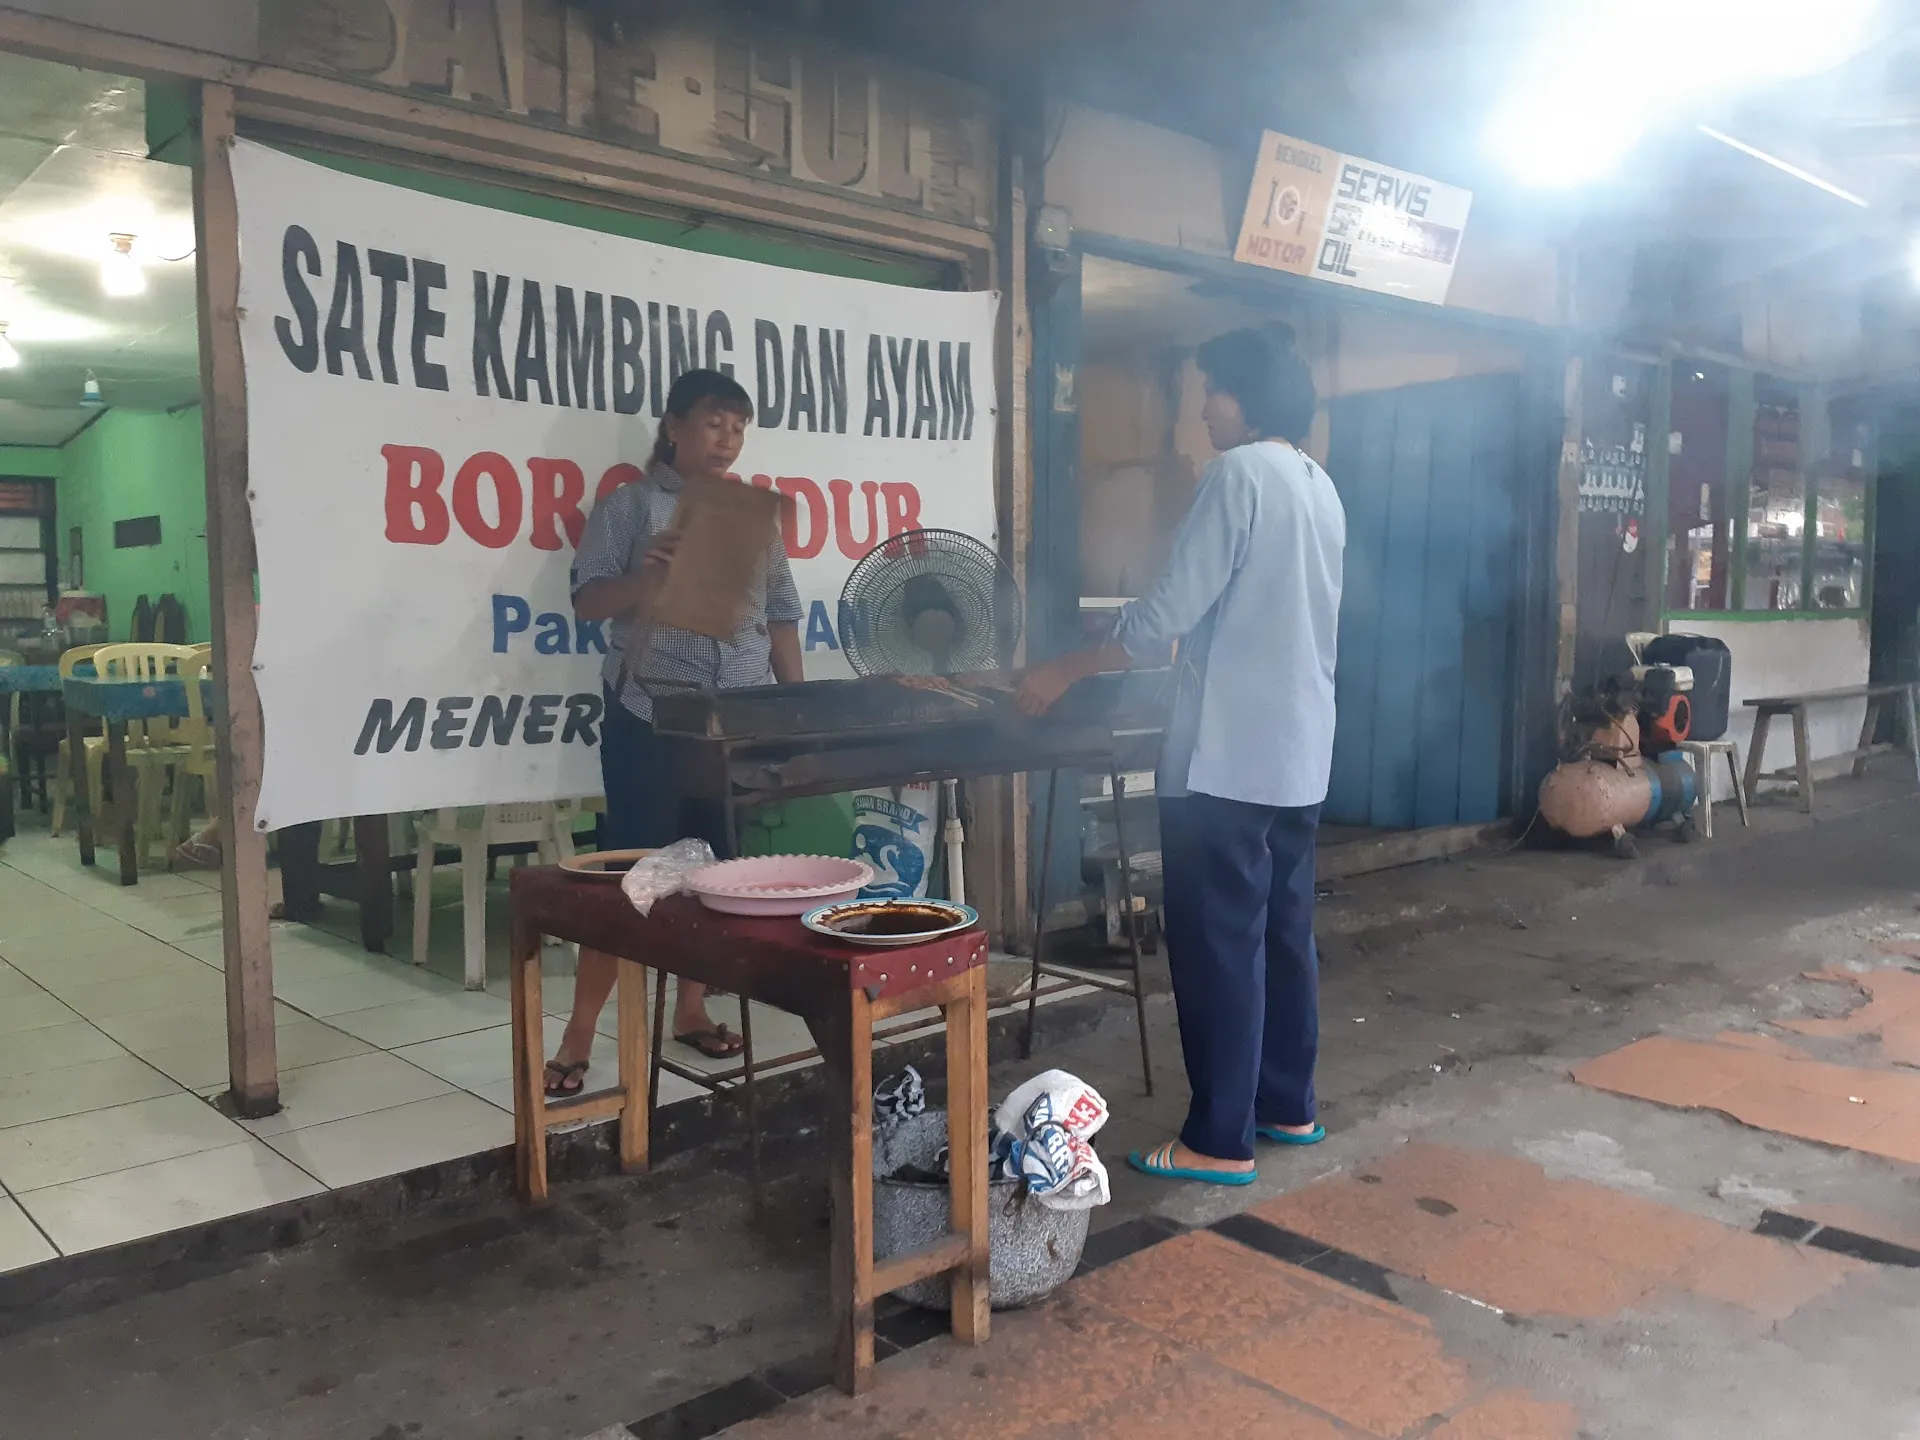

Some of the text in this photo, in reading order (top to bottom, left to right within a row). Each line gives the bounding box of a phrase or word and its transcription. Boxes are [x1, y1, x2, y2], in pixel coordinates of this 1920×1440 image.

[1337, 163, 1432, 218] SERVIS
[1246, 233, 1307, 265] MOTOR
[1317, 238, 1357, 278] OIL
[273, 224, 973, 442] SATE KAMBING DAN AYAM
[855, 797, 912, 821] SWAN BRAND
